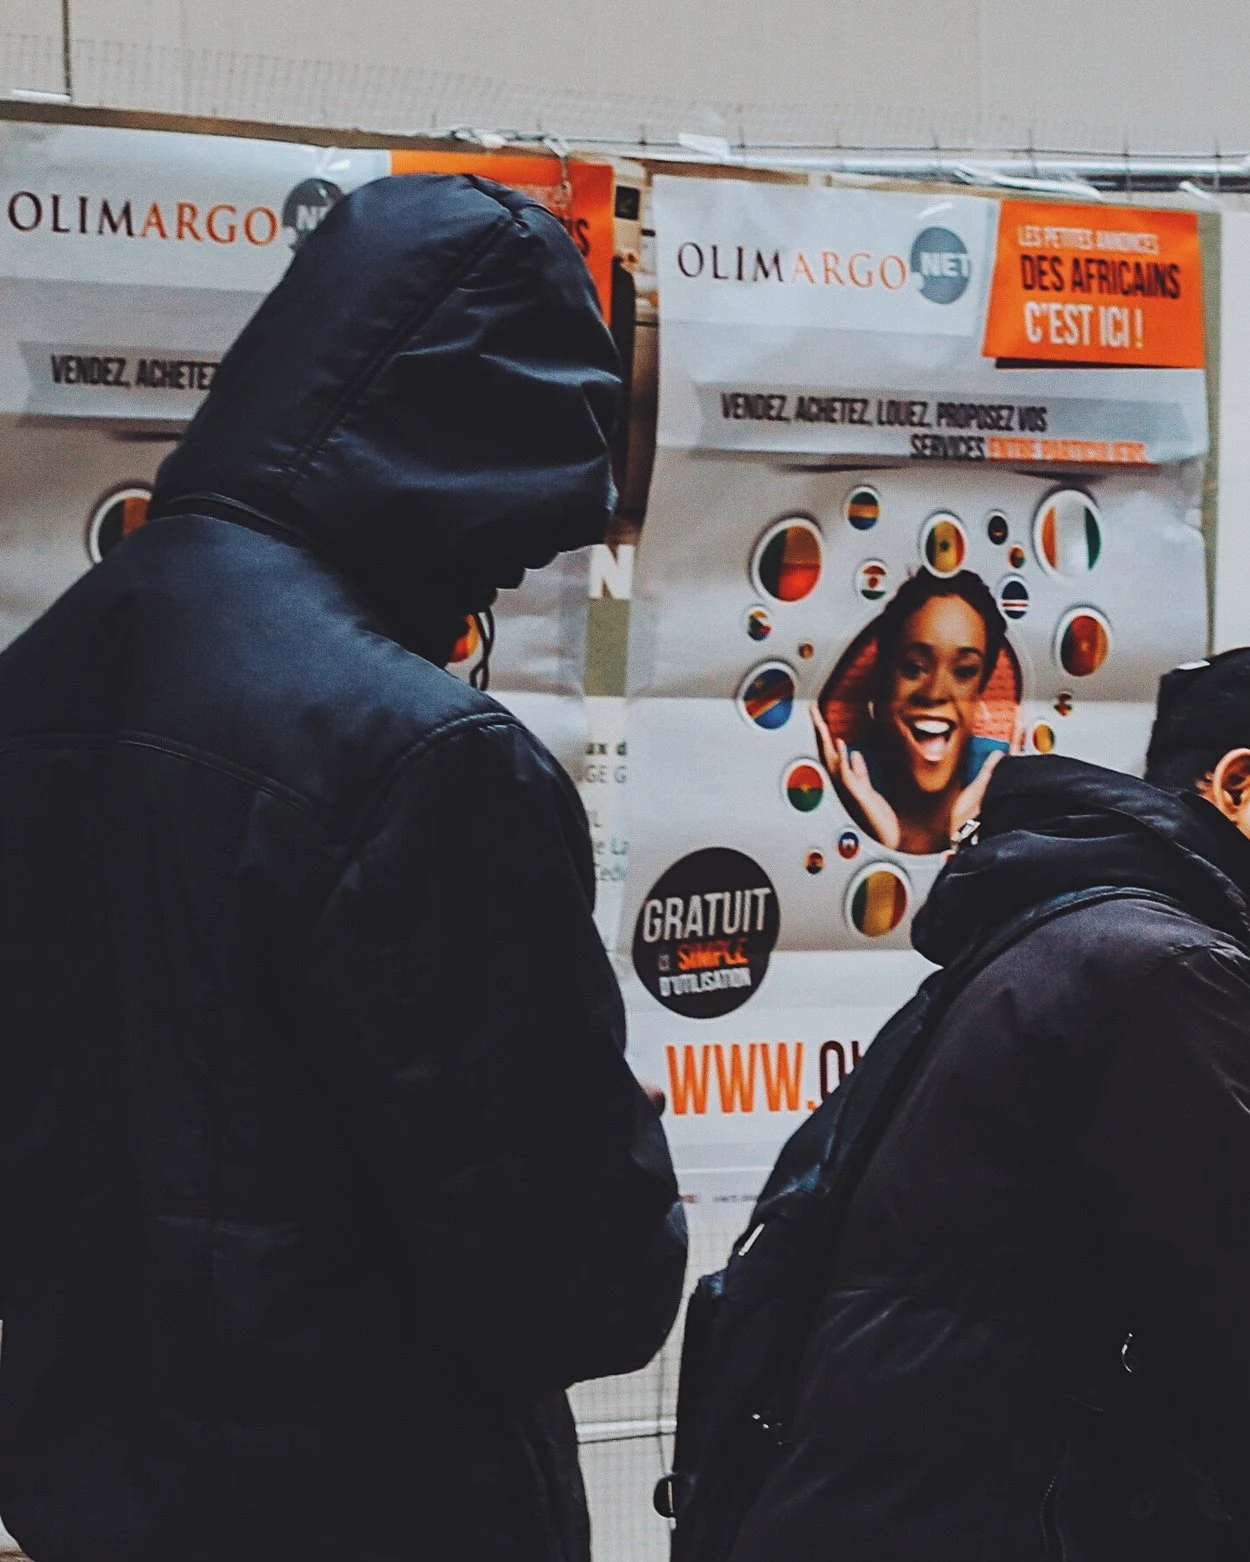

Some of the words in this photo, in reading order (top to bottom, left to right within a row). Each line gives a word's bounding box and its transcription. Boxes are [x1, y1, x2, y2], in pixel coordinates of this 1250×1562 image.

[8, 190, 279, 246] OLIMARGO
[677, 240, 908, 290] OLIMARGO
[1020, 254, 1065, 291] DES
[1071, 257, 1181, 299] AFRICAINS
[1024, 301, 1093, 345] C'EST
[136, 358, 221, 391] ACHETE
[643, 887, 772, 943] GRATUIT
